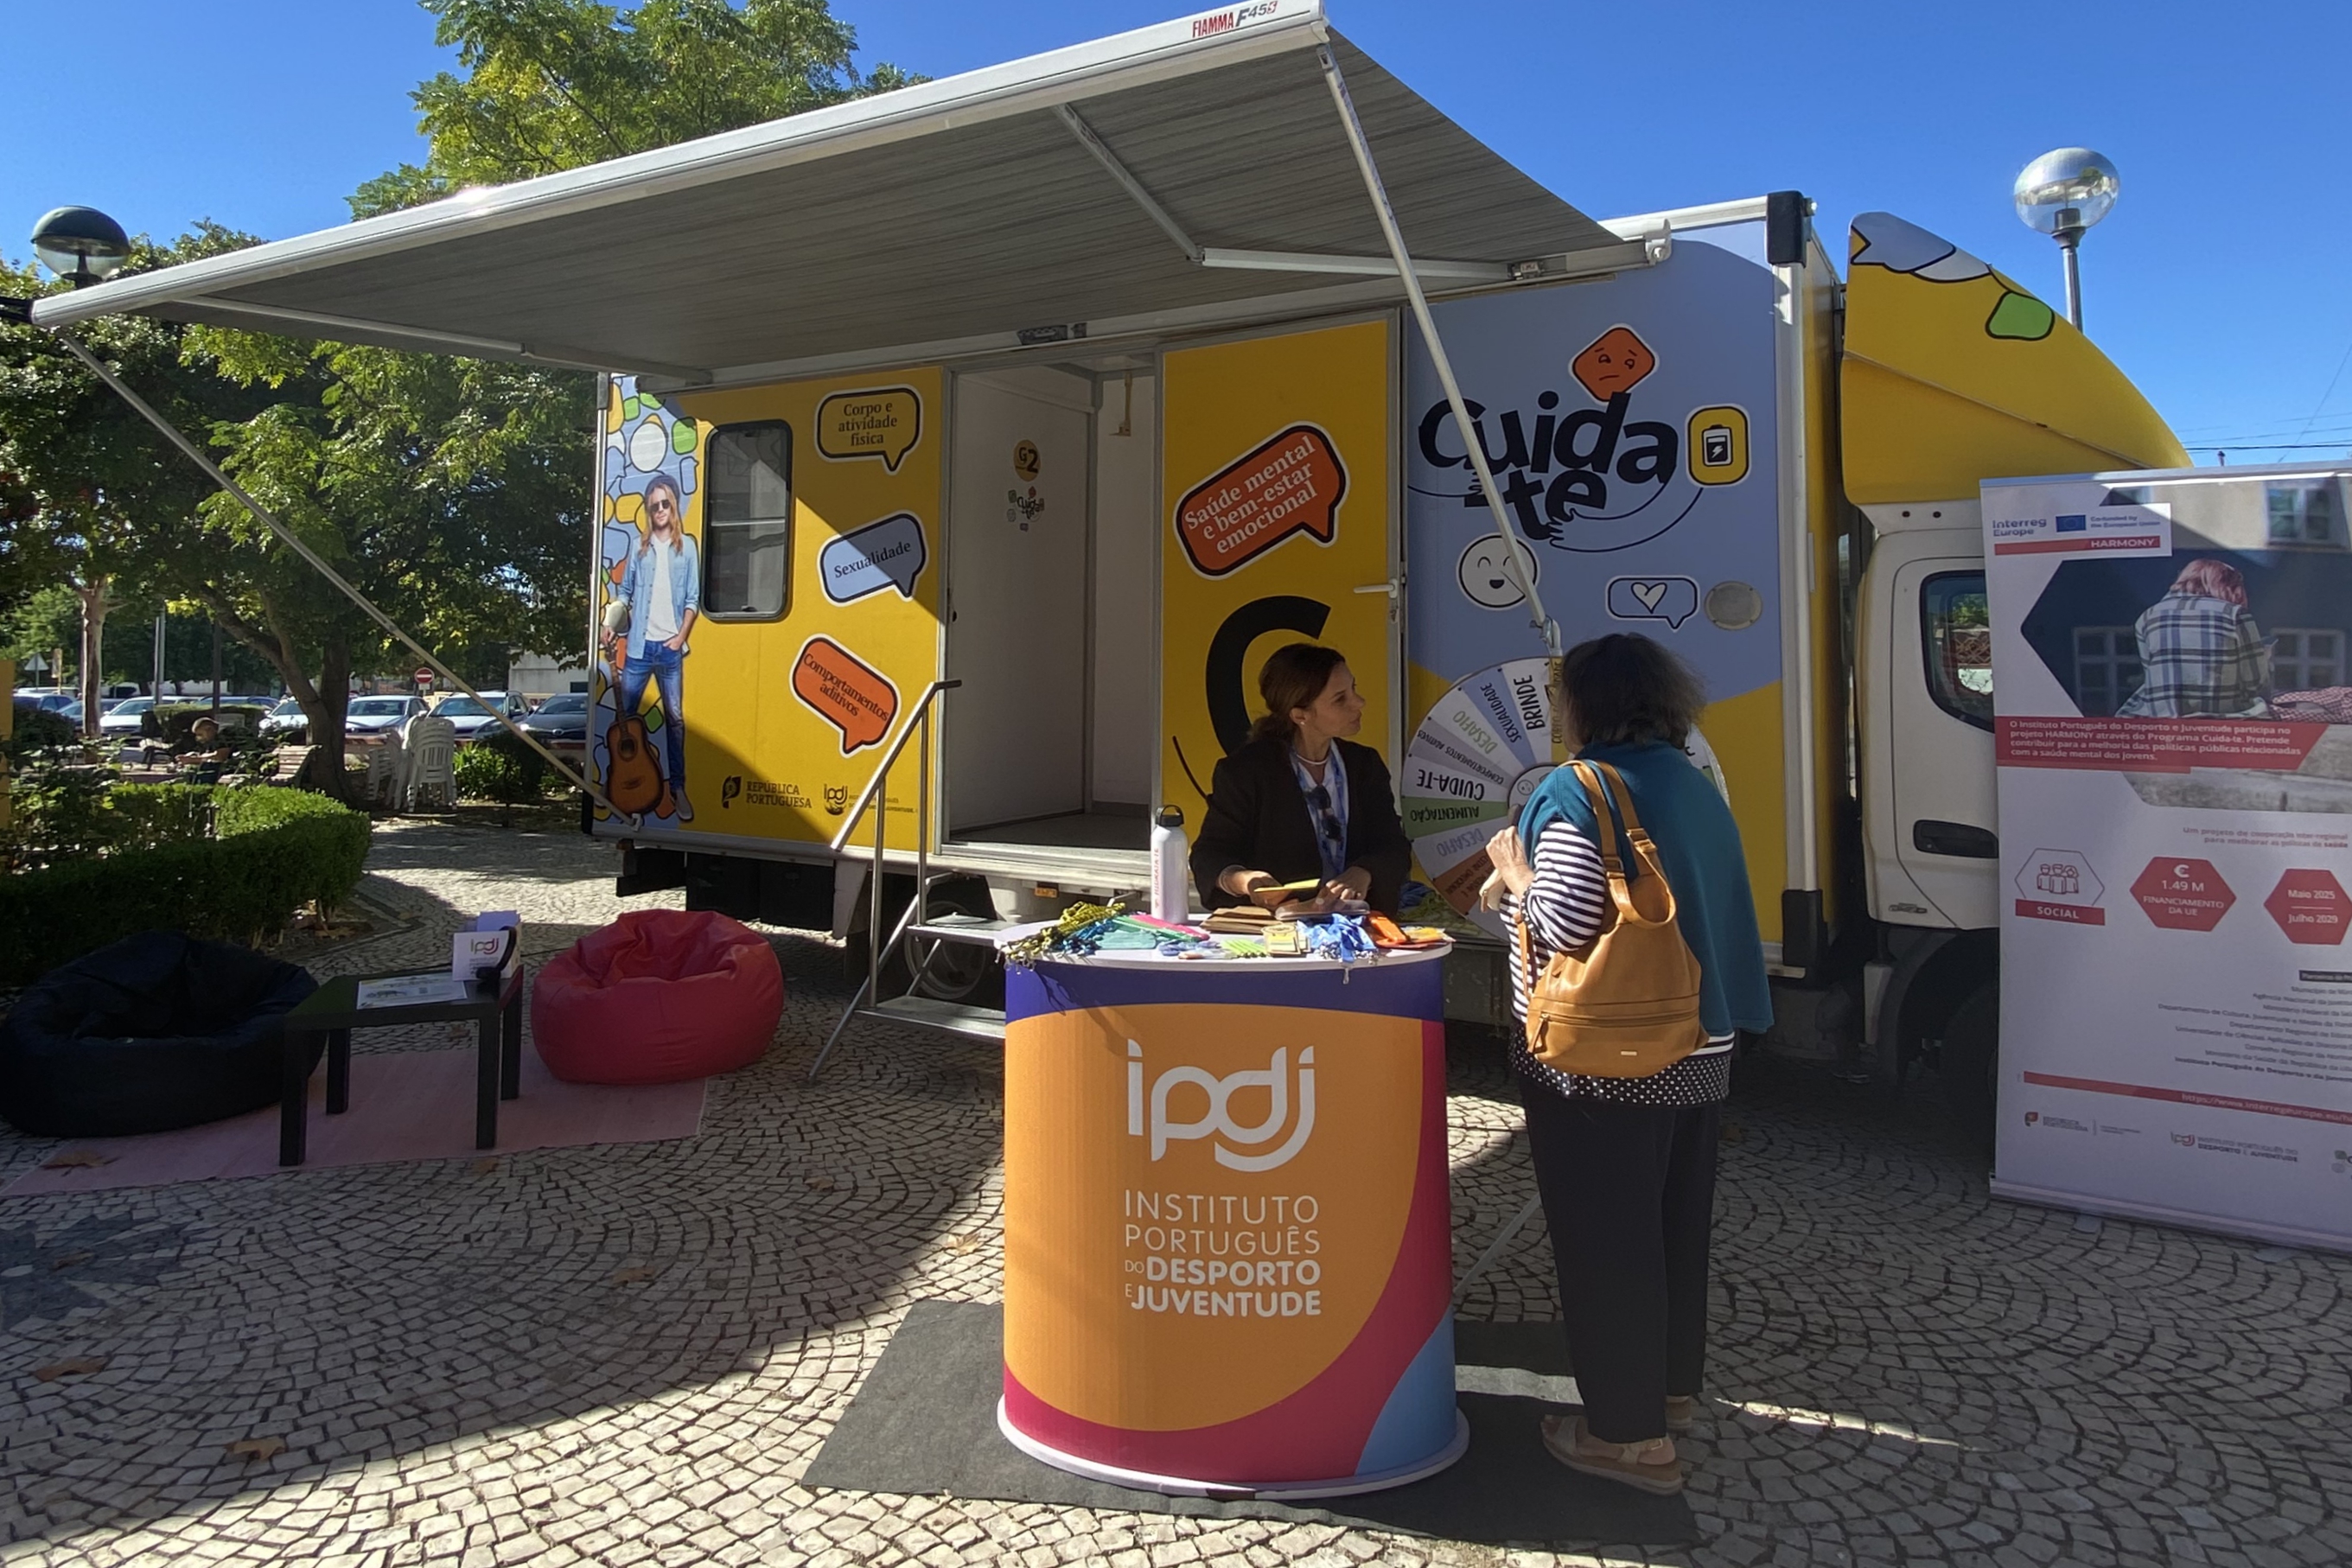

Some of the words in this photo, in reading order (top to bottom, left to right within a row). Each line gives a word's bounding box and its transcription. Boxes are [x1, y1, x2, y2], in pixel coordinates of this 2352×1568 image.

[1193, 12, 1233, 38] FIAMMA
[838, 414, 897, 432] atividade
[844, 404, 882, 417] Corpo
[886, 403, 892, 411] e
[1418, 391, 1679, 484] Cuida
[1184, 488, 1242, 529] Saúde
[1245, 436, 1316, 494] mental
[1203, 526, 1215, 539] e
[1214, 462, 1313, 532] bem-estar
[1216, 481, 1318, 554] emocional
[1992, 519, 2047, 529] Interreg
[1993, 528, 2034, 537] Europe
[2091, 539, 2155, 548] HARMONY
[834, 542, 911, 577] Sexualidade
[804, 653, 889, 721] Comportamentos
[820, 684, 859, 717] aditivos
[1480, 682, 1522, 743] SEXUALIDADE
[1514, 675, 1546, 730] BRINDE
[1453, 711, 1498, 755] DESAFIO
[2061, 721, 2107, 731] Português
[2125, 723, 2170, 732] Desporto
[2181, 724, 2232, 733] Juventude
[2234, 725, 2276, 735] participa
[2147, 733, 2199, 743] Programa
[2040, 749, 2068, 757] saúde
[2069, 749, 2102, 758] mental
[2132, 742, 2150, 750] das
[2199, 743, 2240, 753] públicas
[2242, 746, 2301, 755] relacionadas
[1445, 747, 1504, 785] COMPORTAMENTOS
[747, 781, 800, 795] REPÚBLICA
[824, 783, 848, 805] ipdj
[1416, 769, 1485, 800] CUIDA-TE
[746, 794, 812, 808] PORTUGUESA
[1437, 828, 1485, 857] DESAFIO
[2228, 838, 2268, 846] melhorar
[2162, 880, 2188, 890] 1.49
[2192, 882, 2204, 892] M
[2288, 889, 2311, 899] Maio
[2036, 906, 2079, 919] SOCIAL
[2143, 896, 2224, 908] FINANCIAMENTO
[2288, 915, 2314, 924] Julho
[1128, 1039, 1316, 1172] ipdj
[1125, 1189, 1319, 1224] INSTITUTO
[1125, 1224, 1321, 1255] PORTUGUÊS
[1125, 1259, 1144, 1274] DO
[1147, 1256, 1321, 1286] DESPORTO
[1125, 1284, 1132, 1297] E
[1131, 1285, 1321, 1317] JUVENTUDE
